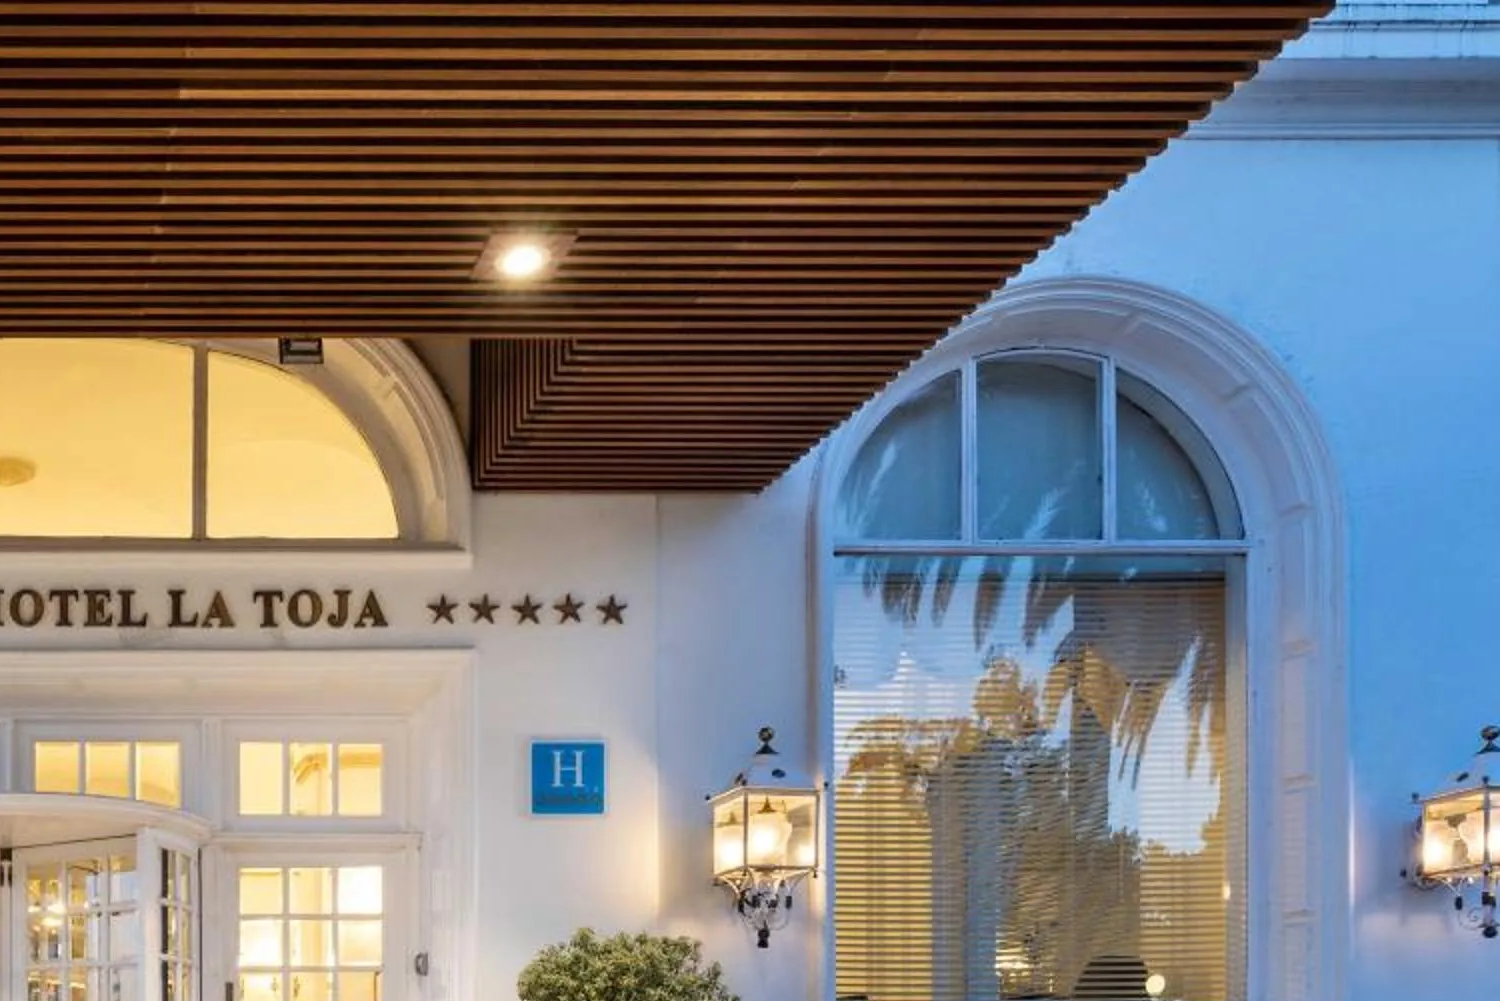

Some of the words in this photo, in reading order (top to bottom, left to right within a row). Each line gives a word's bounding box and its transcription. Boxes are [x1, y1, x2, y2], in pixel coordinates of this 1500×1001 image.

[166, 586, 236, 629] LA
[251, 587, 390, 630] TOJA
[551, 749, 586, 788] H
